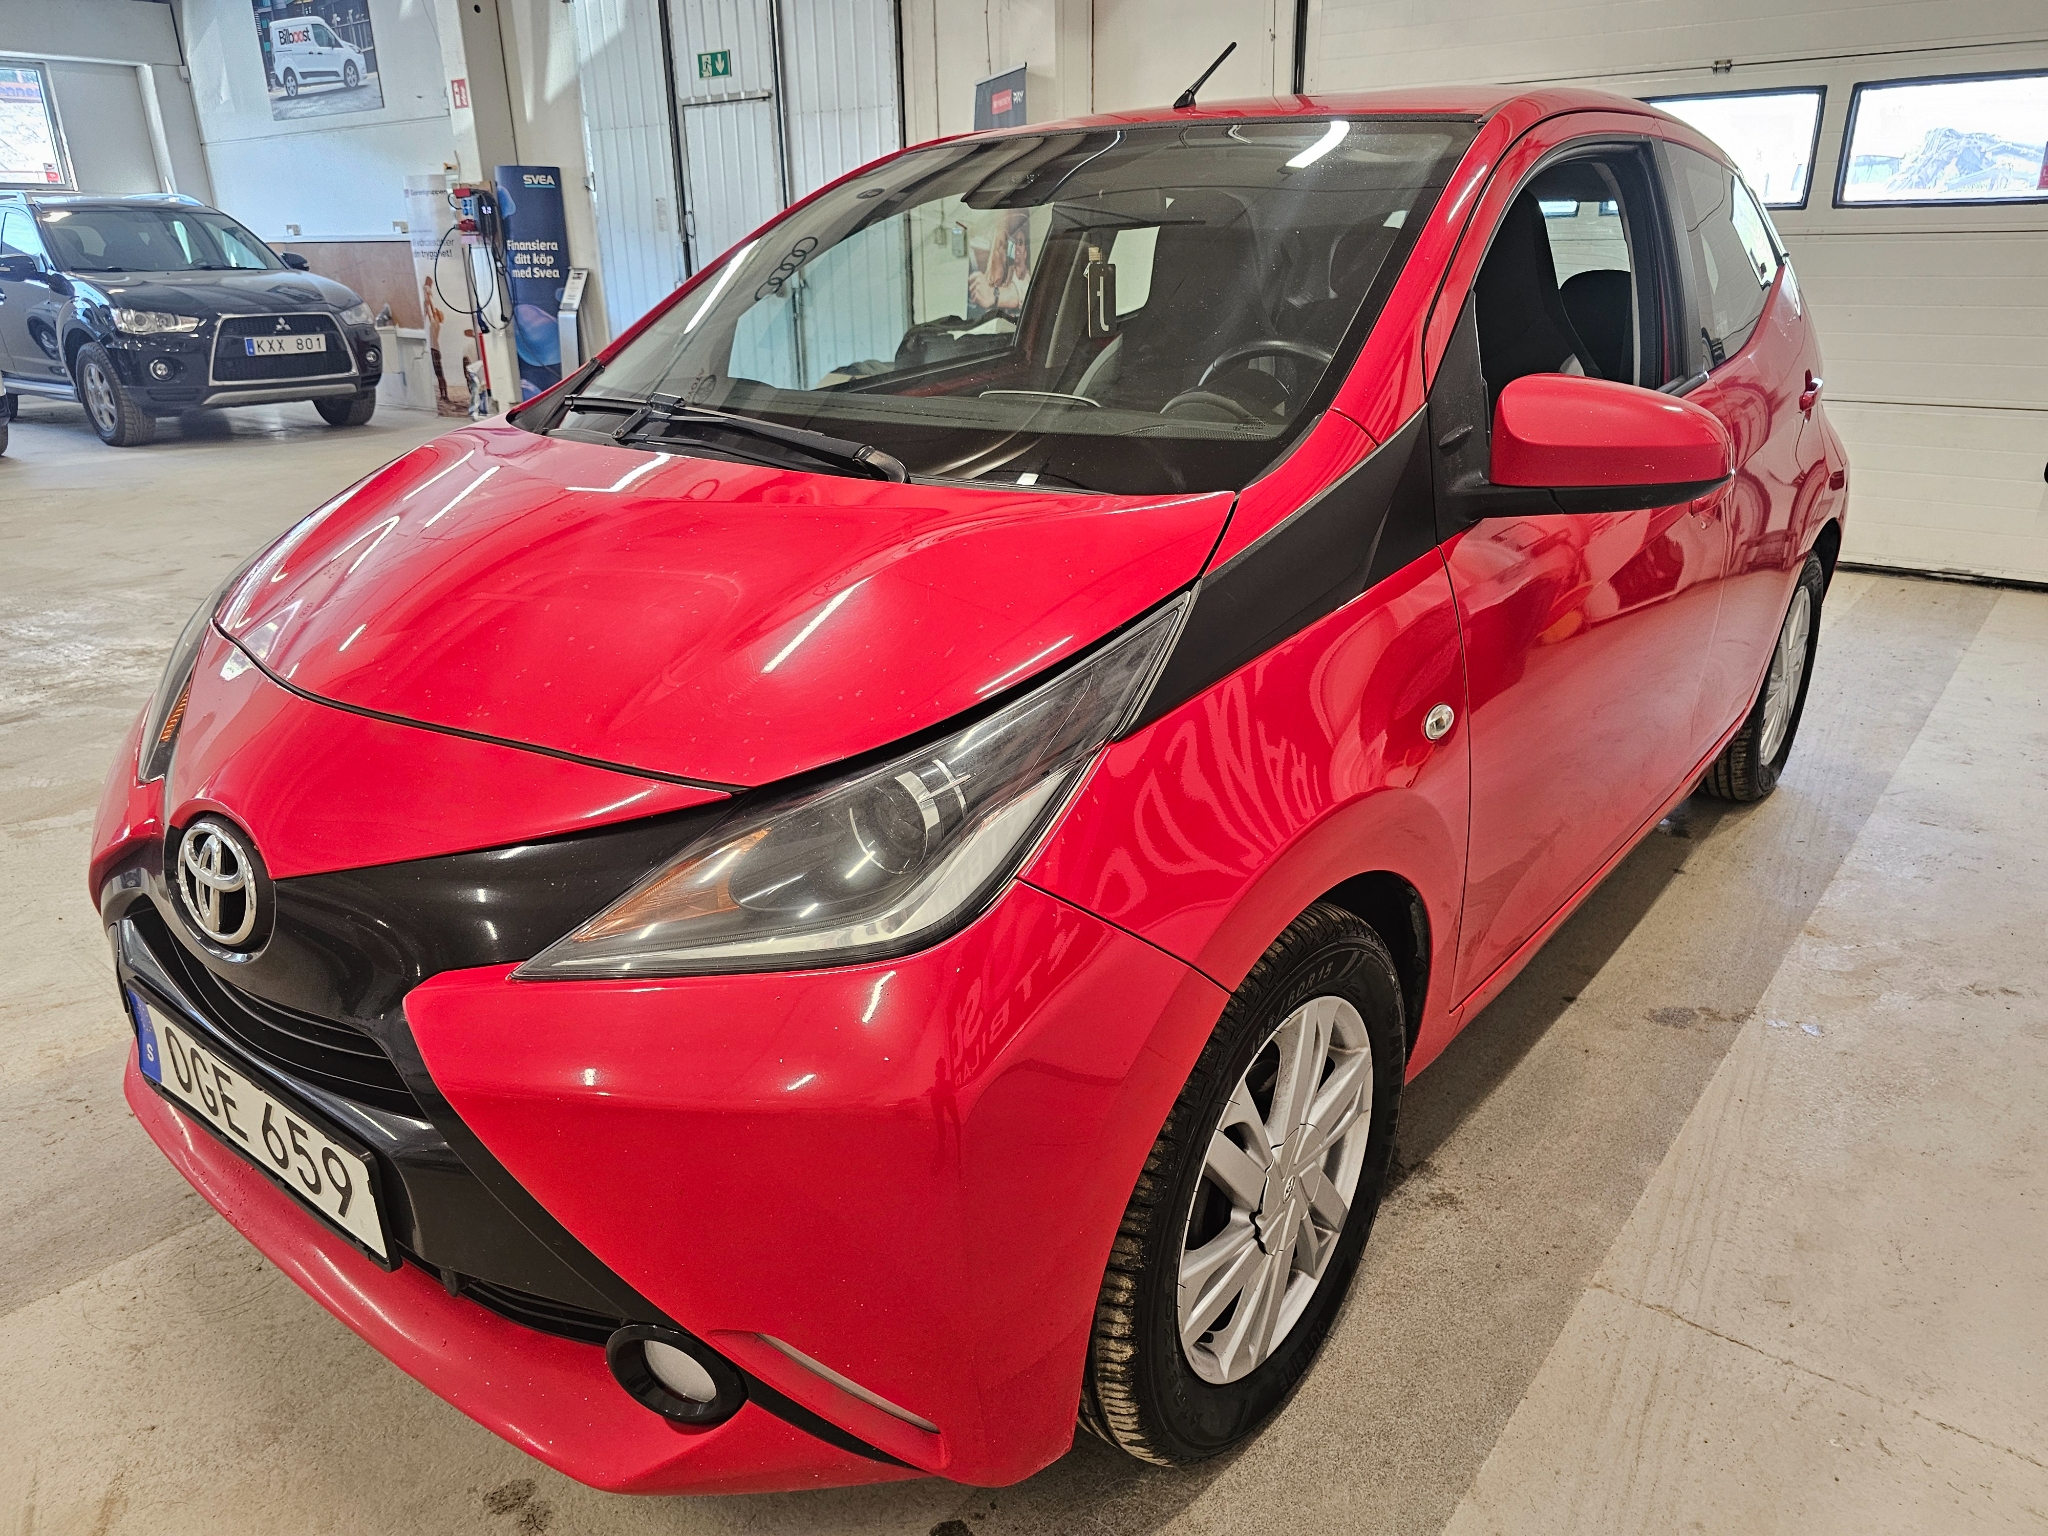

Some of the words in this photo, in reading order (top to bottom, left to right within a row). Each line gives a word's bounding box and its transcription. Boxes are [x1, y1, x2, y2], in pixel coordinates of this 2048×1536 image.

[278, 27, 311, 45] Bilboost
[523, 174, 555, 185] SVEA
[506, 239, 558, 251] Finansiera
[514, 252, 531, 265] ditt
[532, 252, 554, 266] köp
[512, 266, 532, 278] med
[533, 266, 560, 278] Svea
[256, 339, 286, 353] KXX
[296, 337, 321, 351] 801
[146, 1043, 154, 1062] S
[164, 1026, 250, 1142] OGE
[261, 1101, 353, 1218] 659
